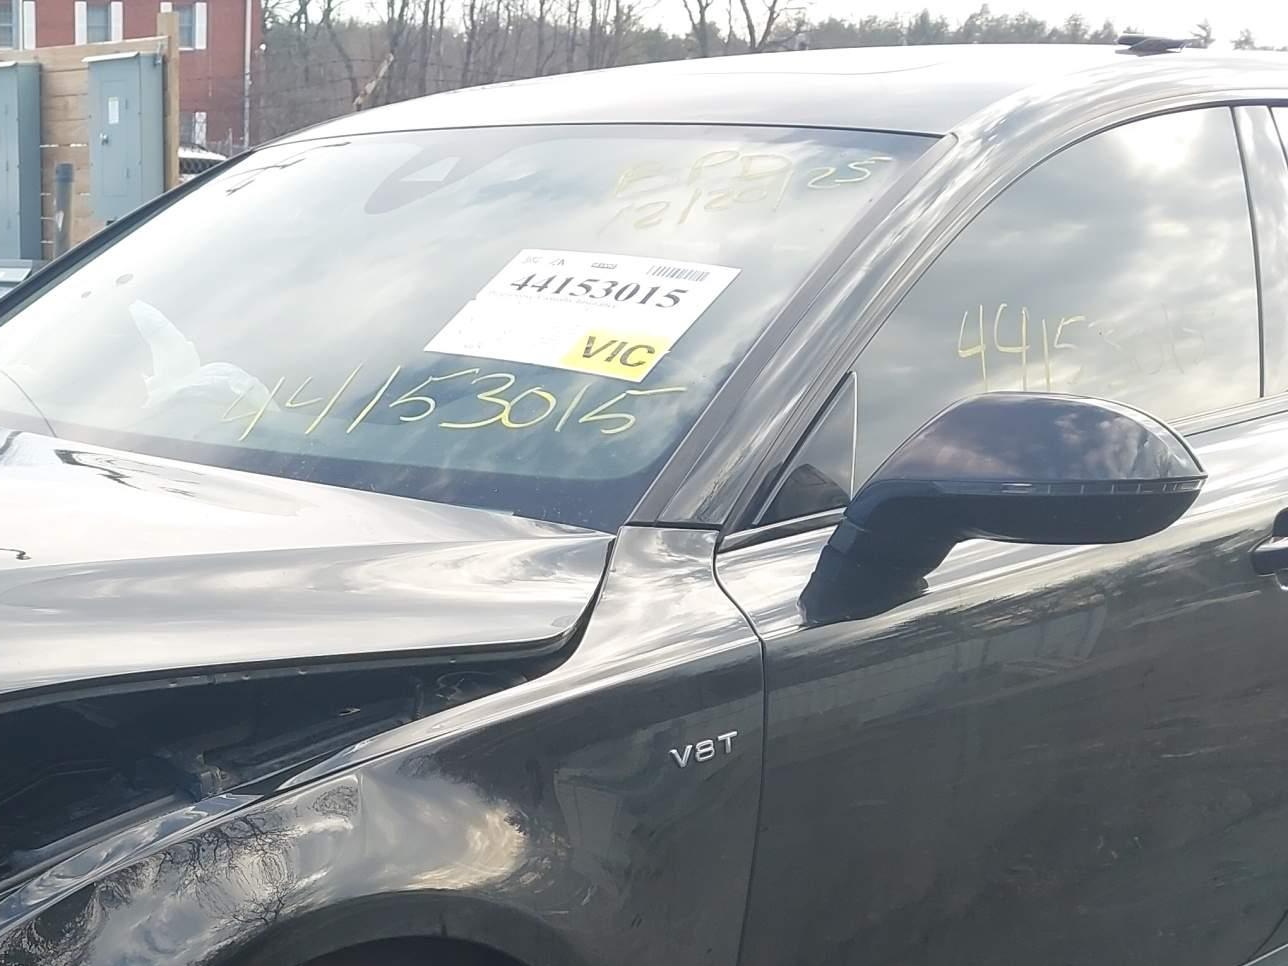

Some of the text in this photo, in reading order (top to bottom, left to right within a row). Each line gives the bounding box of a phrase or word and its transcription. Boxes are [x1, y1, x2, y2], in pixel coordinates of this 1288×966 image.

[510, 272, 688, 309] 44153015
[582, 335, 656, 368] VIC
[221, 363, 688, 441] 44153015
[669, 730, 738, 768] V8T
